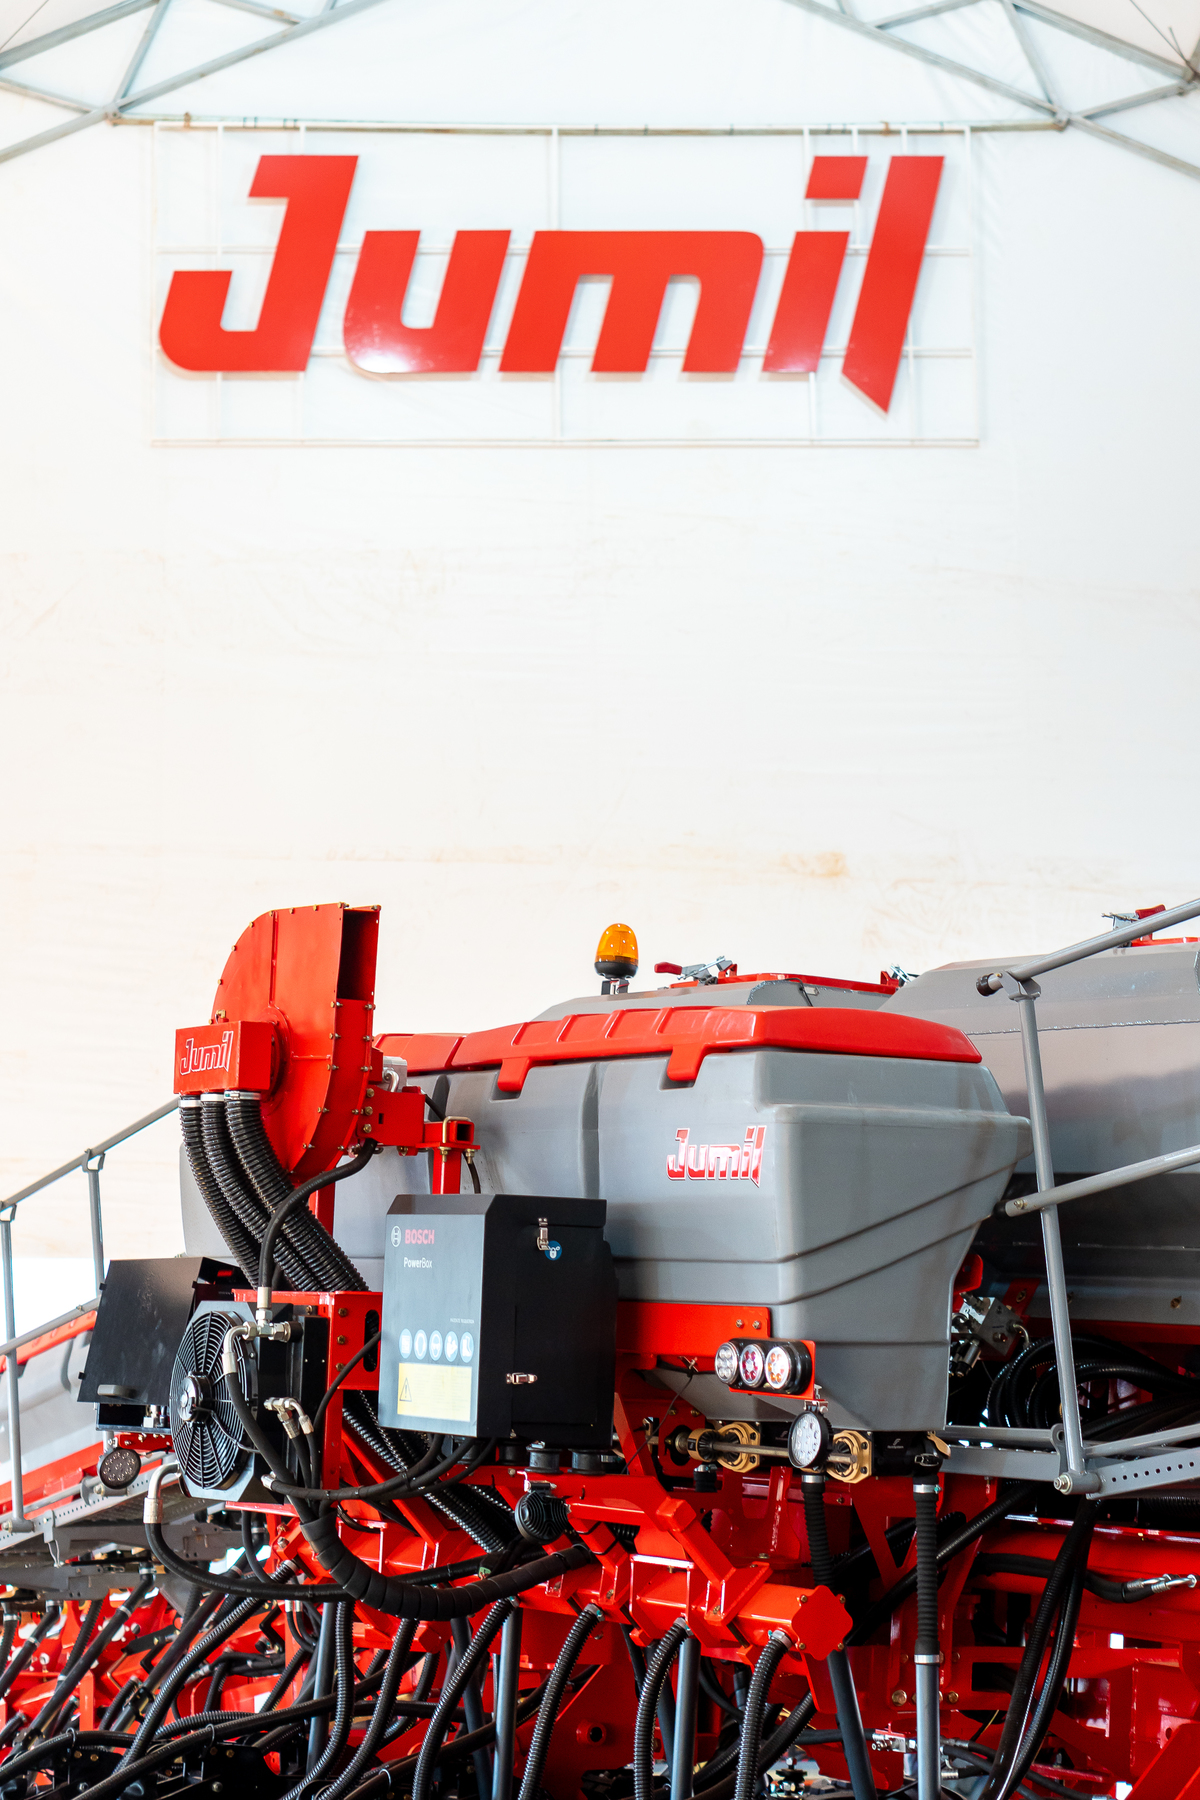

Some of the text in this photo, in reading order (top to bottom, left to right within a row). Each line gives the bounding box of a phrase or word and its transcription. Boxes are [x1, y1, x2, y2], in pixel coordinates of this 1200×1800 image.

[158, 154, 945, 415] Jumil
[180, 1030, 234, 1076] Jumil
[666, 1125, 767, 1188] Jumil
[404, 1229, 435, 1245] BOSCH
[403, 1256, 433, 1269] PowerBox
